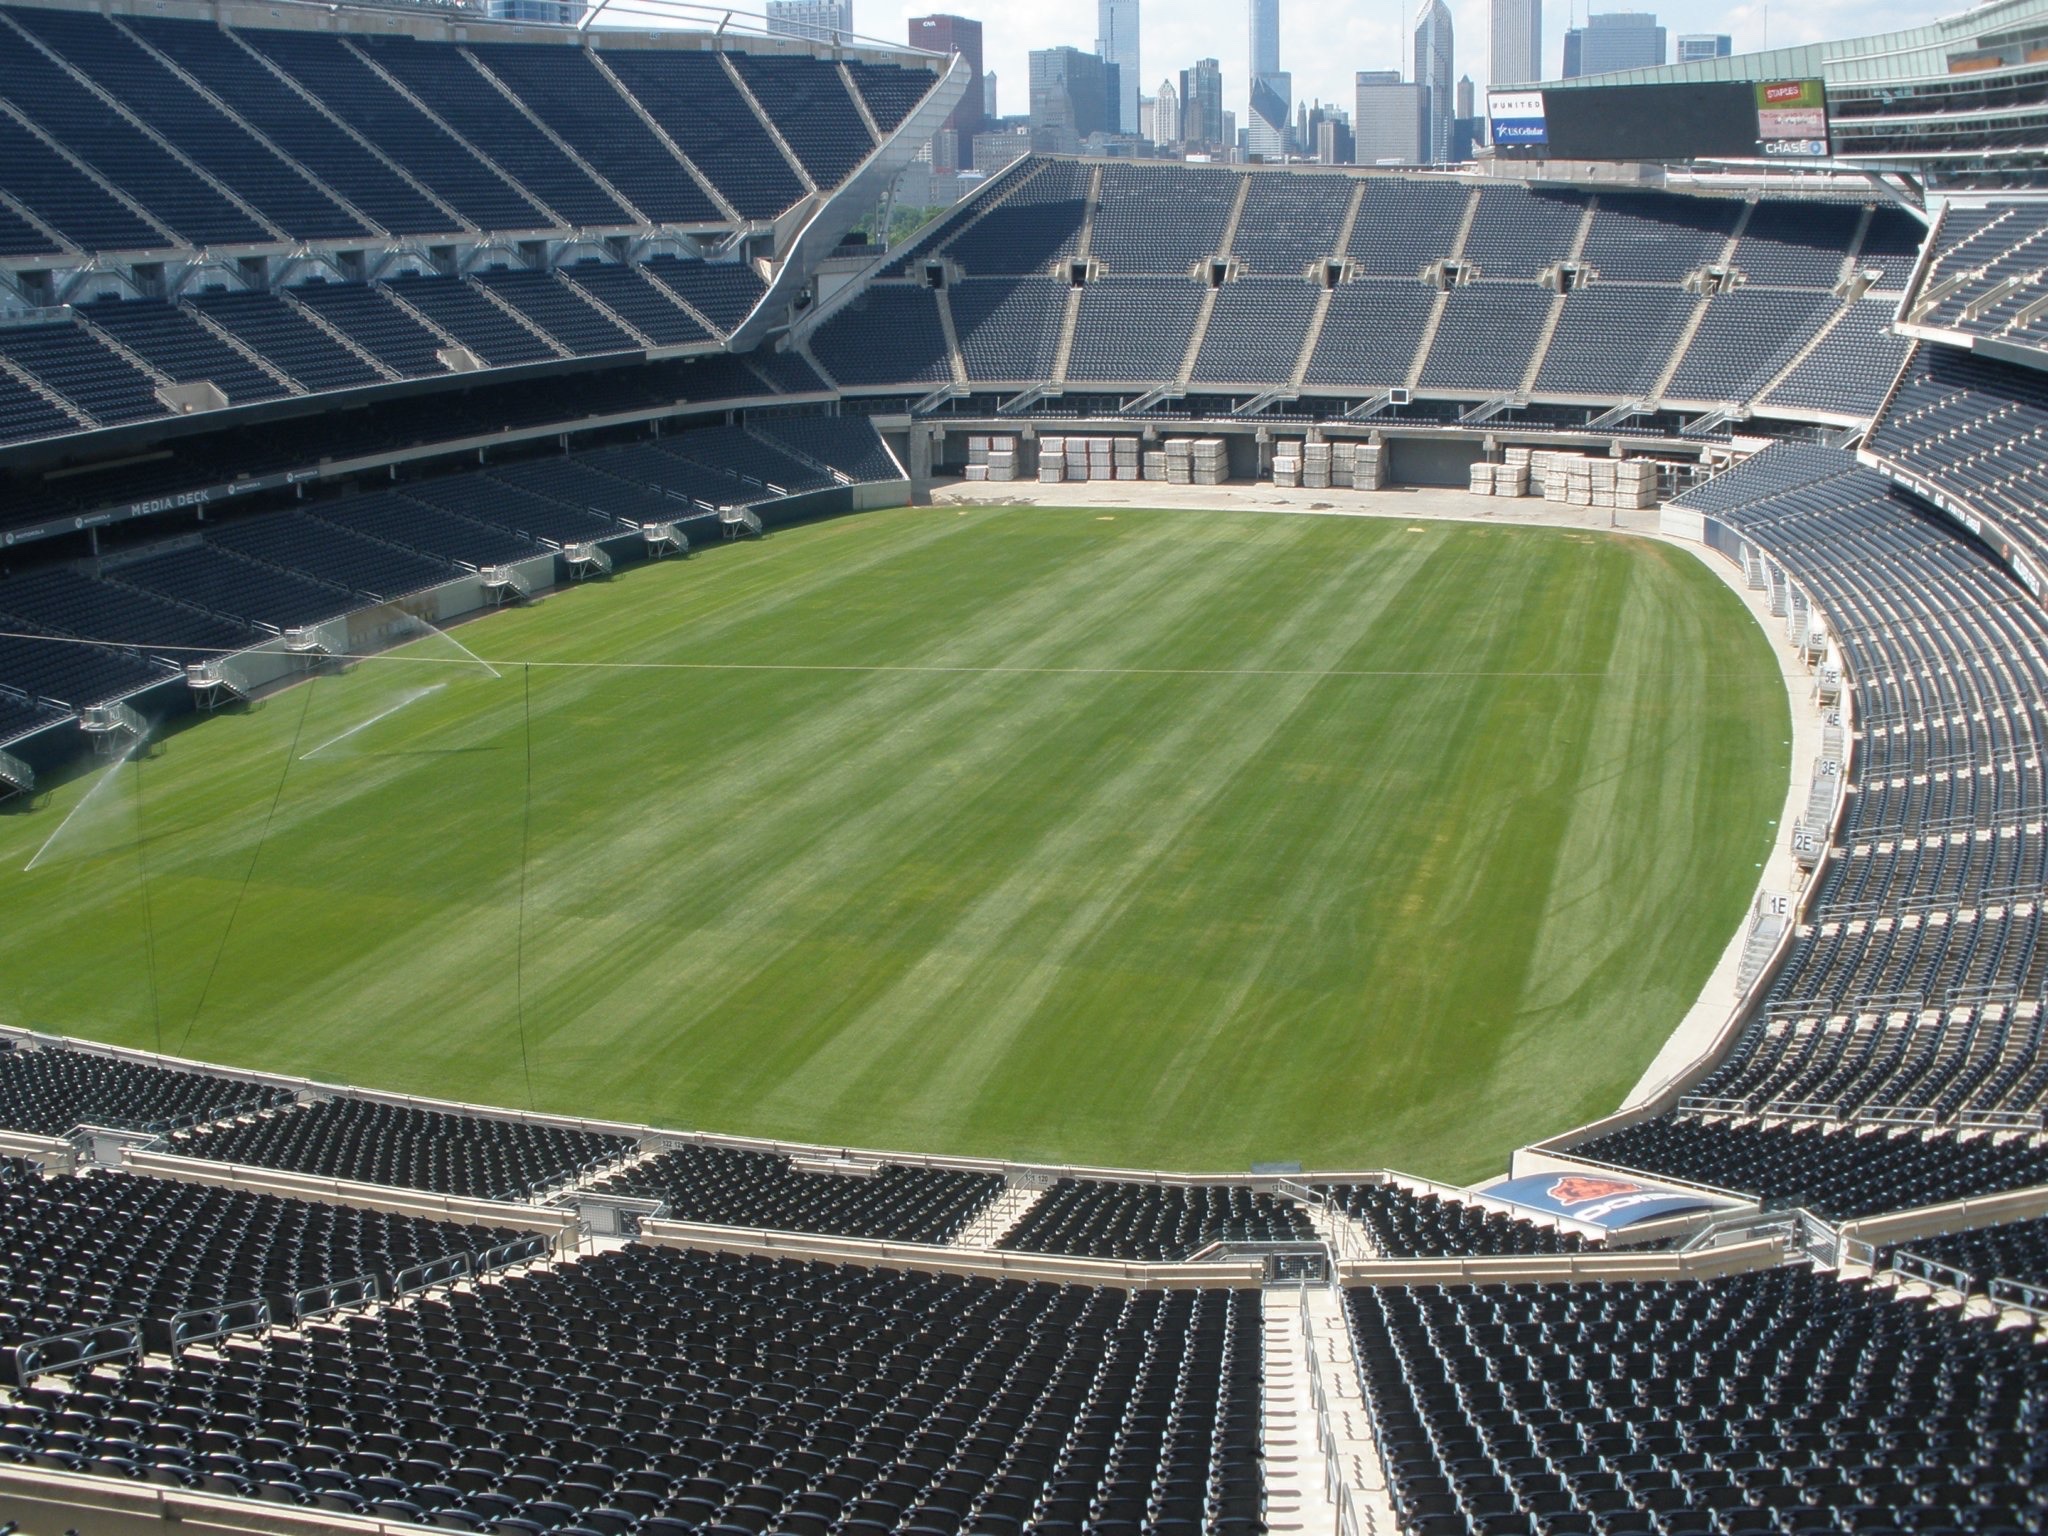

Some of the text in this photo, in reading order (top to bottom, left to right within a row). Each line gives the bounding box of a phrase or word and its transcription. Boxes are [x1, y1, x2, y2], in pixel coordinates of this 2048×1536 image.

[1766, 86, 1799, 98] STAPLES
[1765, 143, 1807, 154] CHASE
[131, 489, 209, 517] MEDIA DECK
[1812, 633, 1823, 645] 6E
[1825, 671, 1837, 684] 5E
[1826, 713, 1840, 727] 4E
[1821, 761, 1836, 776] 3E
[1795, 835, 1811, 851] 2E
[1771, 896, 1787, 914] 1E
